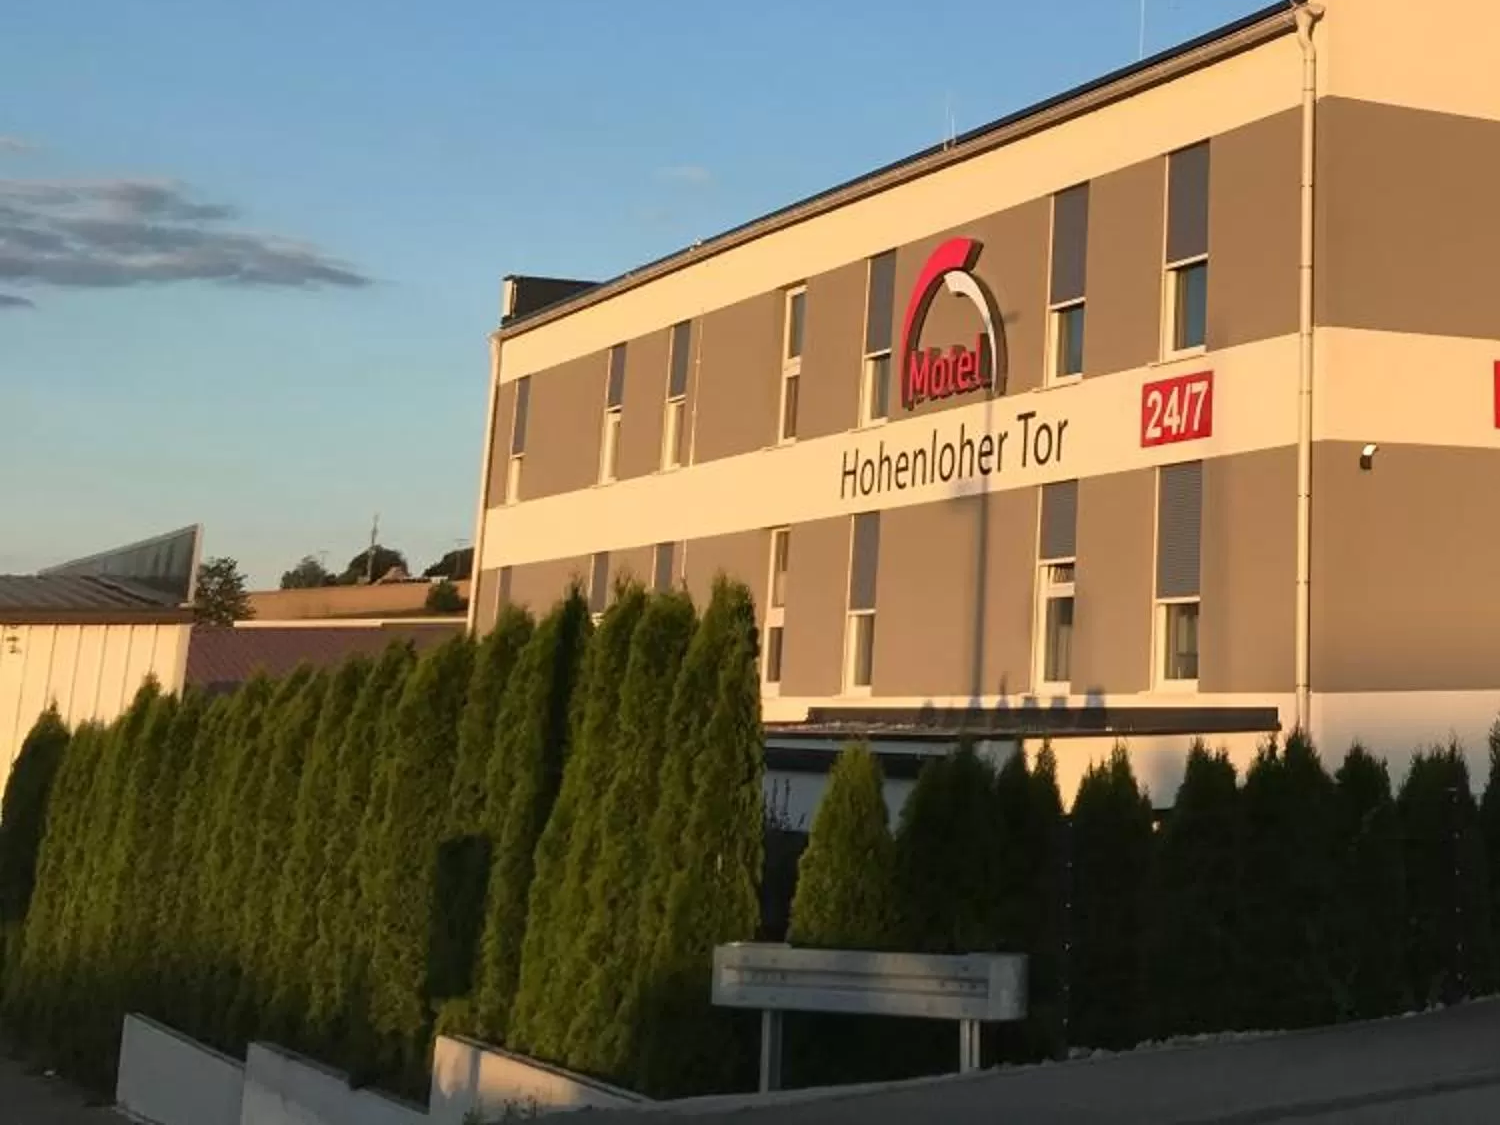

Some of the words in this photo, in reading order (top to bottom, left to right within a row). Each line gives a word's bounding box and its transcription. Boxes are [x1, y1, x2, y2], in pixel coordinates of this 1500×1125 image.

[908, 336, 981, 400] Motel
[1145, 380, 1209, 439] 24/7
[839, 424, 1009, 500] Hohenloher
[1017, 410, 1069, 468] Tor
